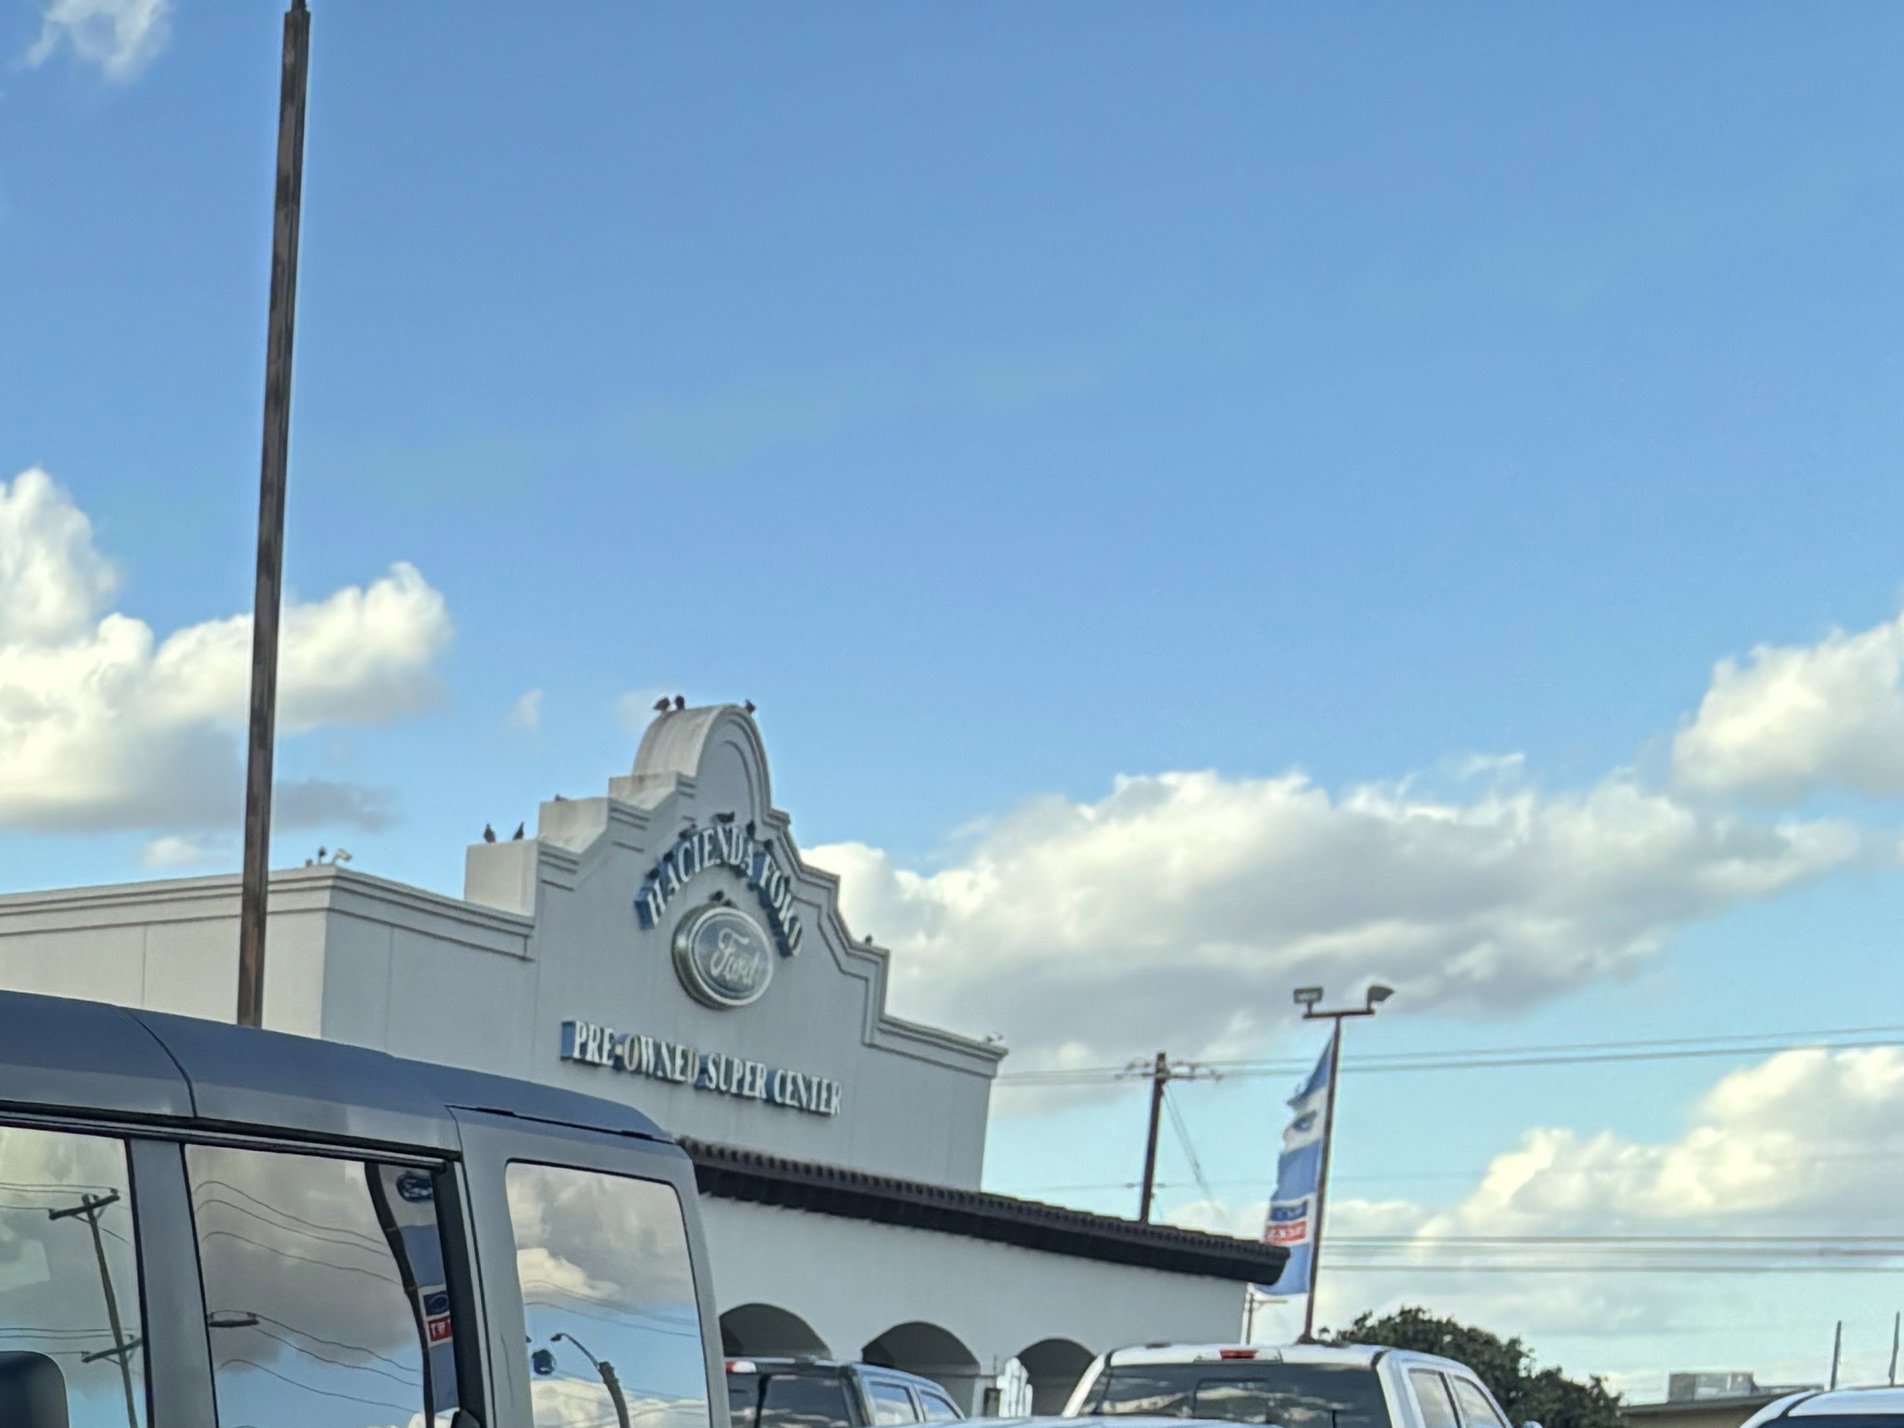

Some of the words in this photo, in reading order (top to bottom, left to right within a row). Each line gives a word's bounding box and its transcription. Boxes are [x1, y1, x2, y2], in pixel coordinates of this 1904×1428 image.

[647, 824, 754, 925] HACIENDA
[709, 927, 762, 987] Ford
[573, 1020, 700, 1084] PRE-OWNED
[705, 1052, 768, 1099] SUPER
[773, 1068, 843, 1115] CENTER
